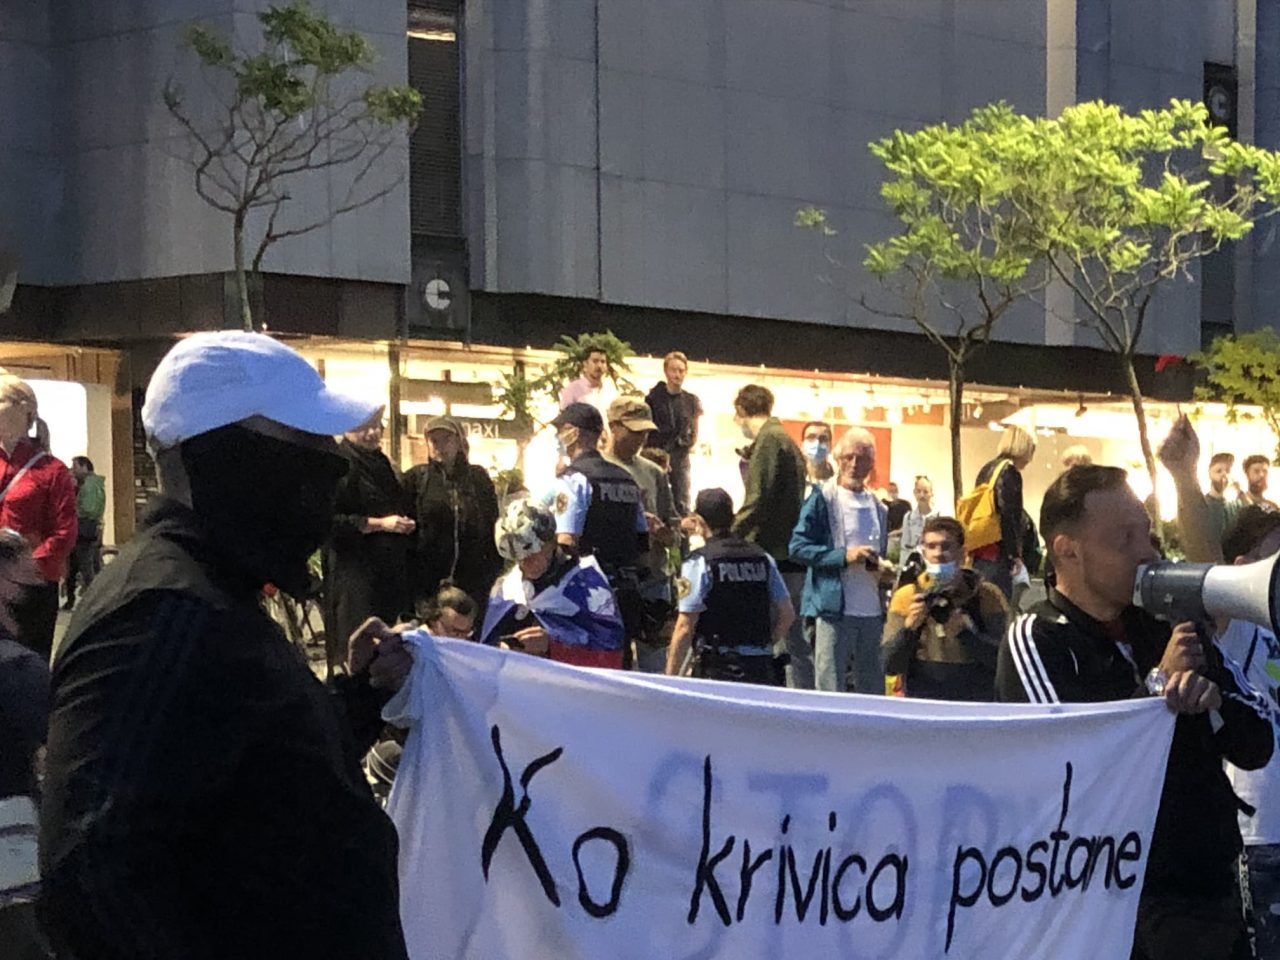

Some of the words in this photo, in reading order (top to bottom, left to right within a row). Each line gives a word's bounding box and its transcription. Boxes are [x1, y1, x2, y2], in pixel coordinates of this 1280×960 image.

[480, 724, 631, 919] Ko
[688, 754, 906, 926] krivica
[944, 762, 1142, 953] postane
